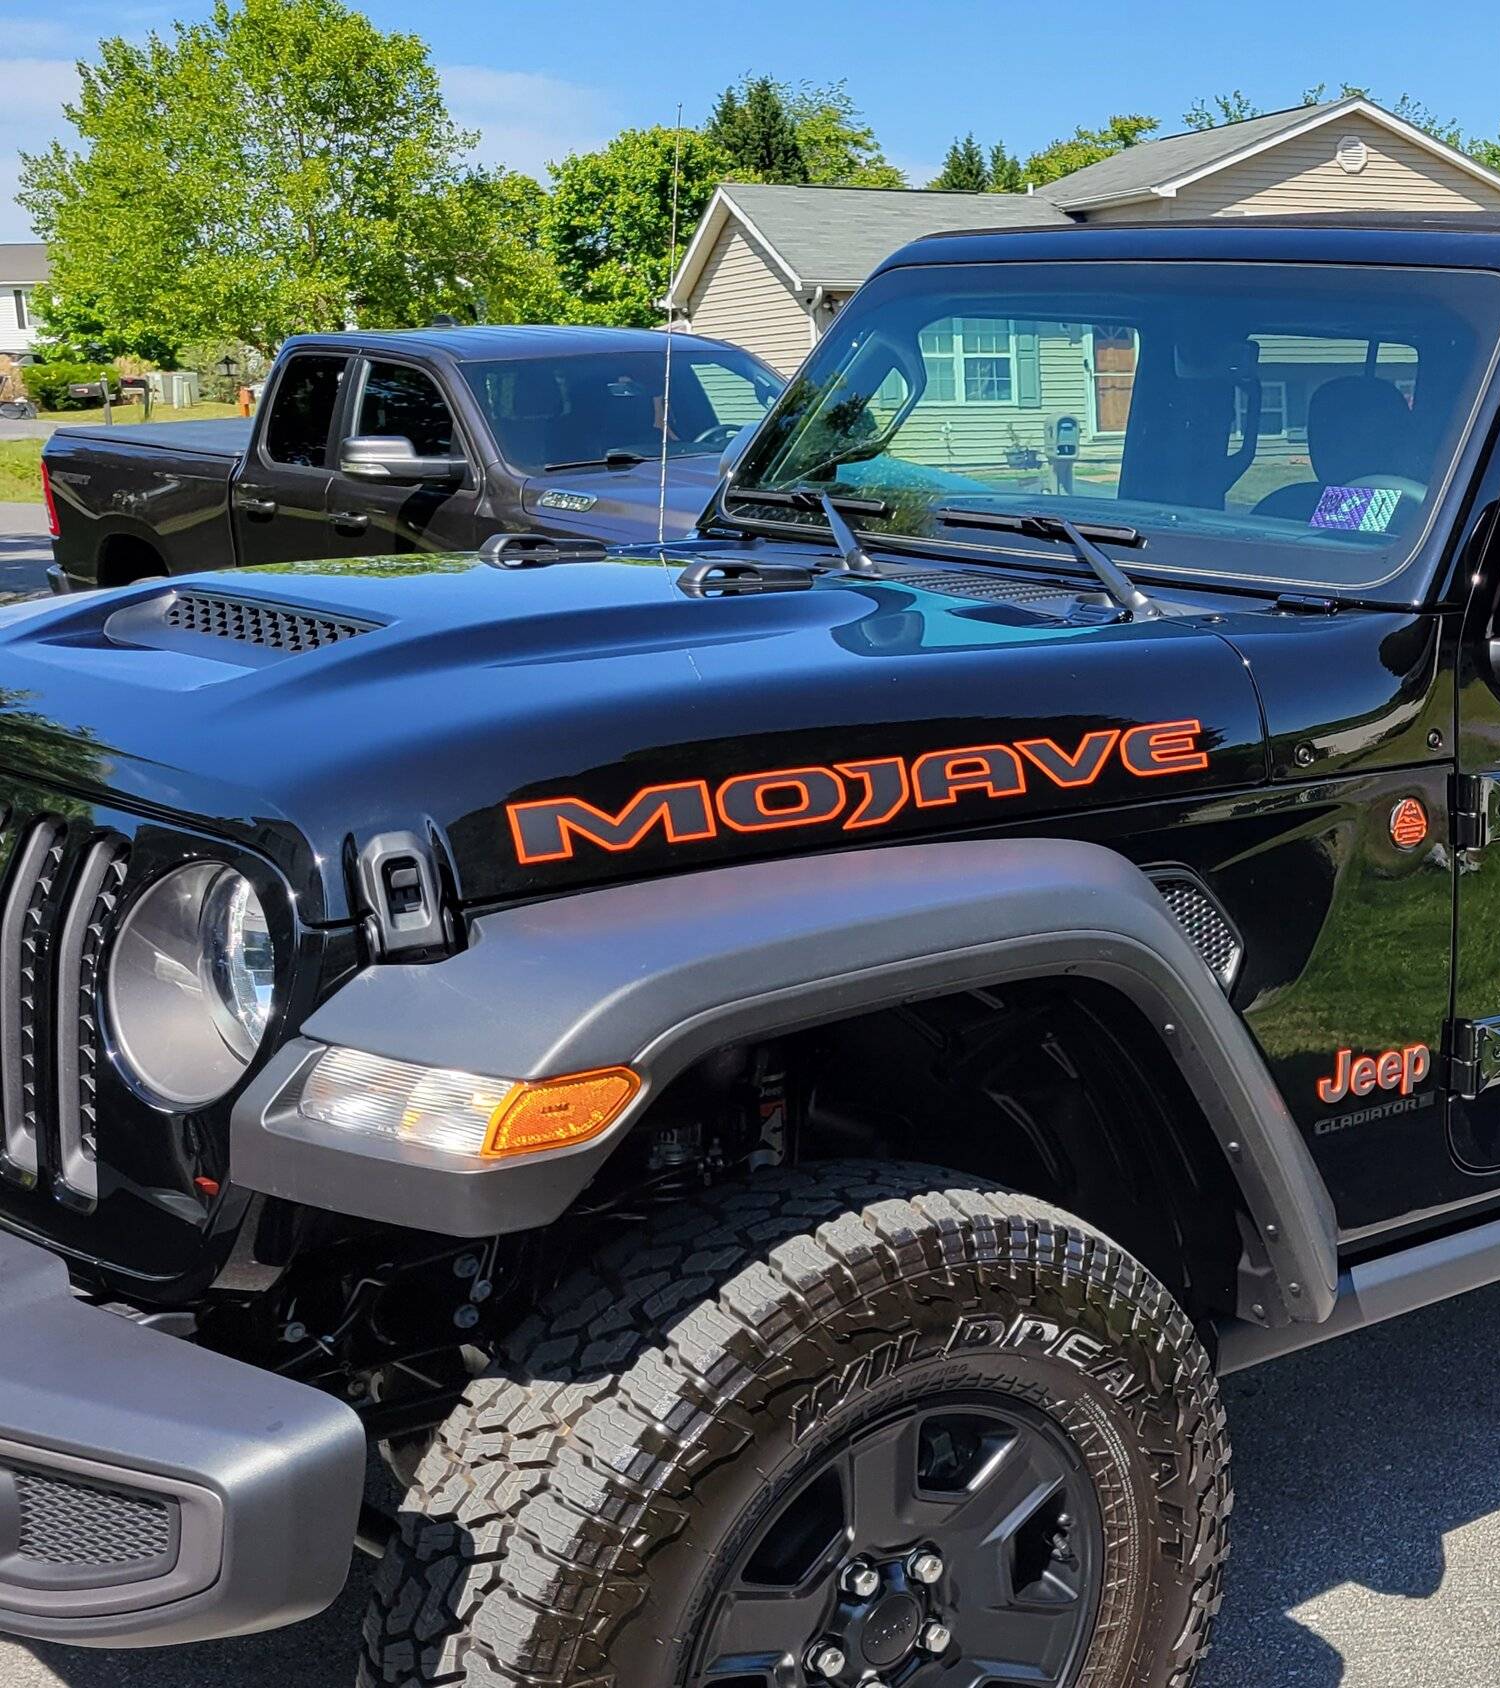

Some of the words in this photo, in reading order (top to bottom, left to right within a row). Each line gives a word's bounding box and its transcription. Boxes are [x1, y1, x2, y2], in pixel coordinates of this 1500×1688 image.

[506, 719, 1208, 864] MOJAVE
[1315, 1042, 1431, 1104] Jeep
[1314, 1098, 1418, 1135] GLADIATOR
